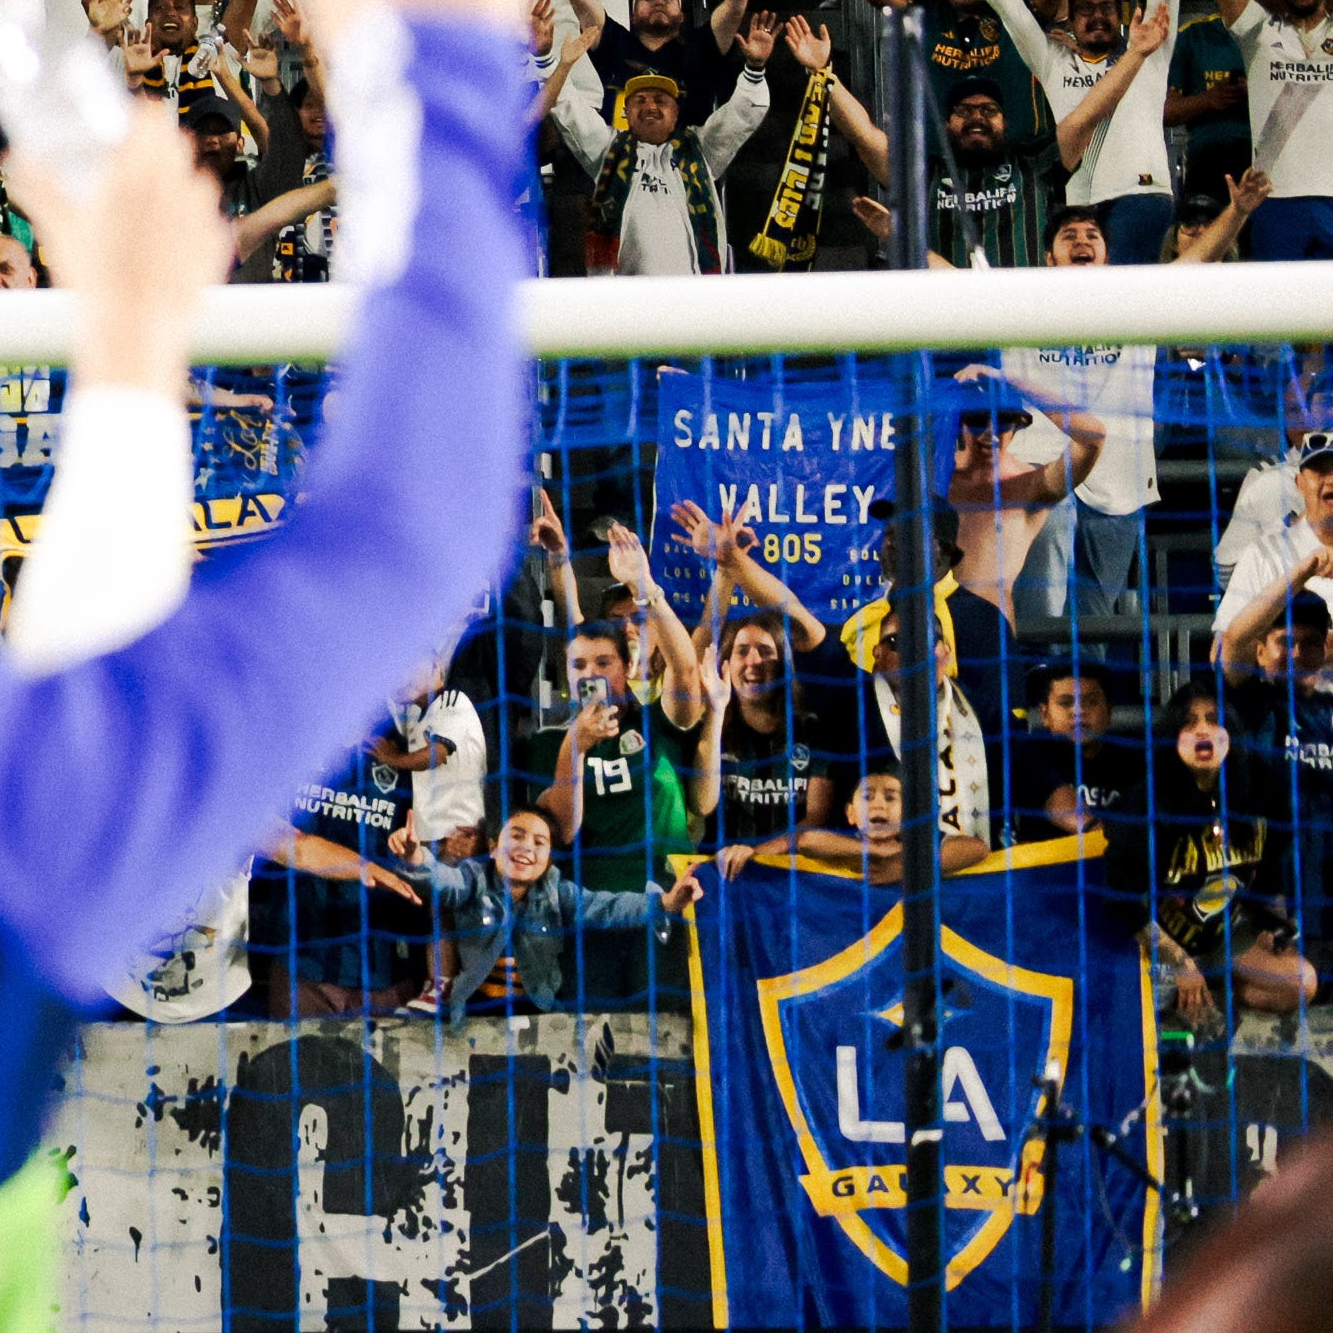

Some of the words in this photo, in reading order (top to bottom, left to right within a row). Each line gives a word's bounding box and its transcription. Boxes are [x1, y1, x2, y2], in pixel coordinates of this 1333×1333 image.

[1063, 70, 1109, 89] HERBA
[774, 171, 808, 230] LIES
[1039, 353, 1121, 367] NUTRITIO
[673, 409, 804, 453] SANTA
[827, 411, 896, 453] YNE
[720, 484, 878, 526] VALLEY
[764, 534, 824, 565] 805
[587, 756, 632, 795] 19
[724, 774, 808, 792] ERBALIF
[294, 797, 393, 830] NUTRITION
[297, 782, 397, 817] HERBALIFE
[835, 1045, 1007, 1144] LA
